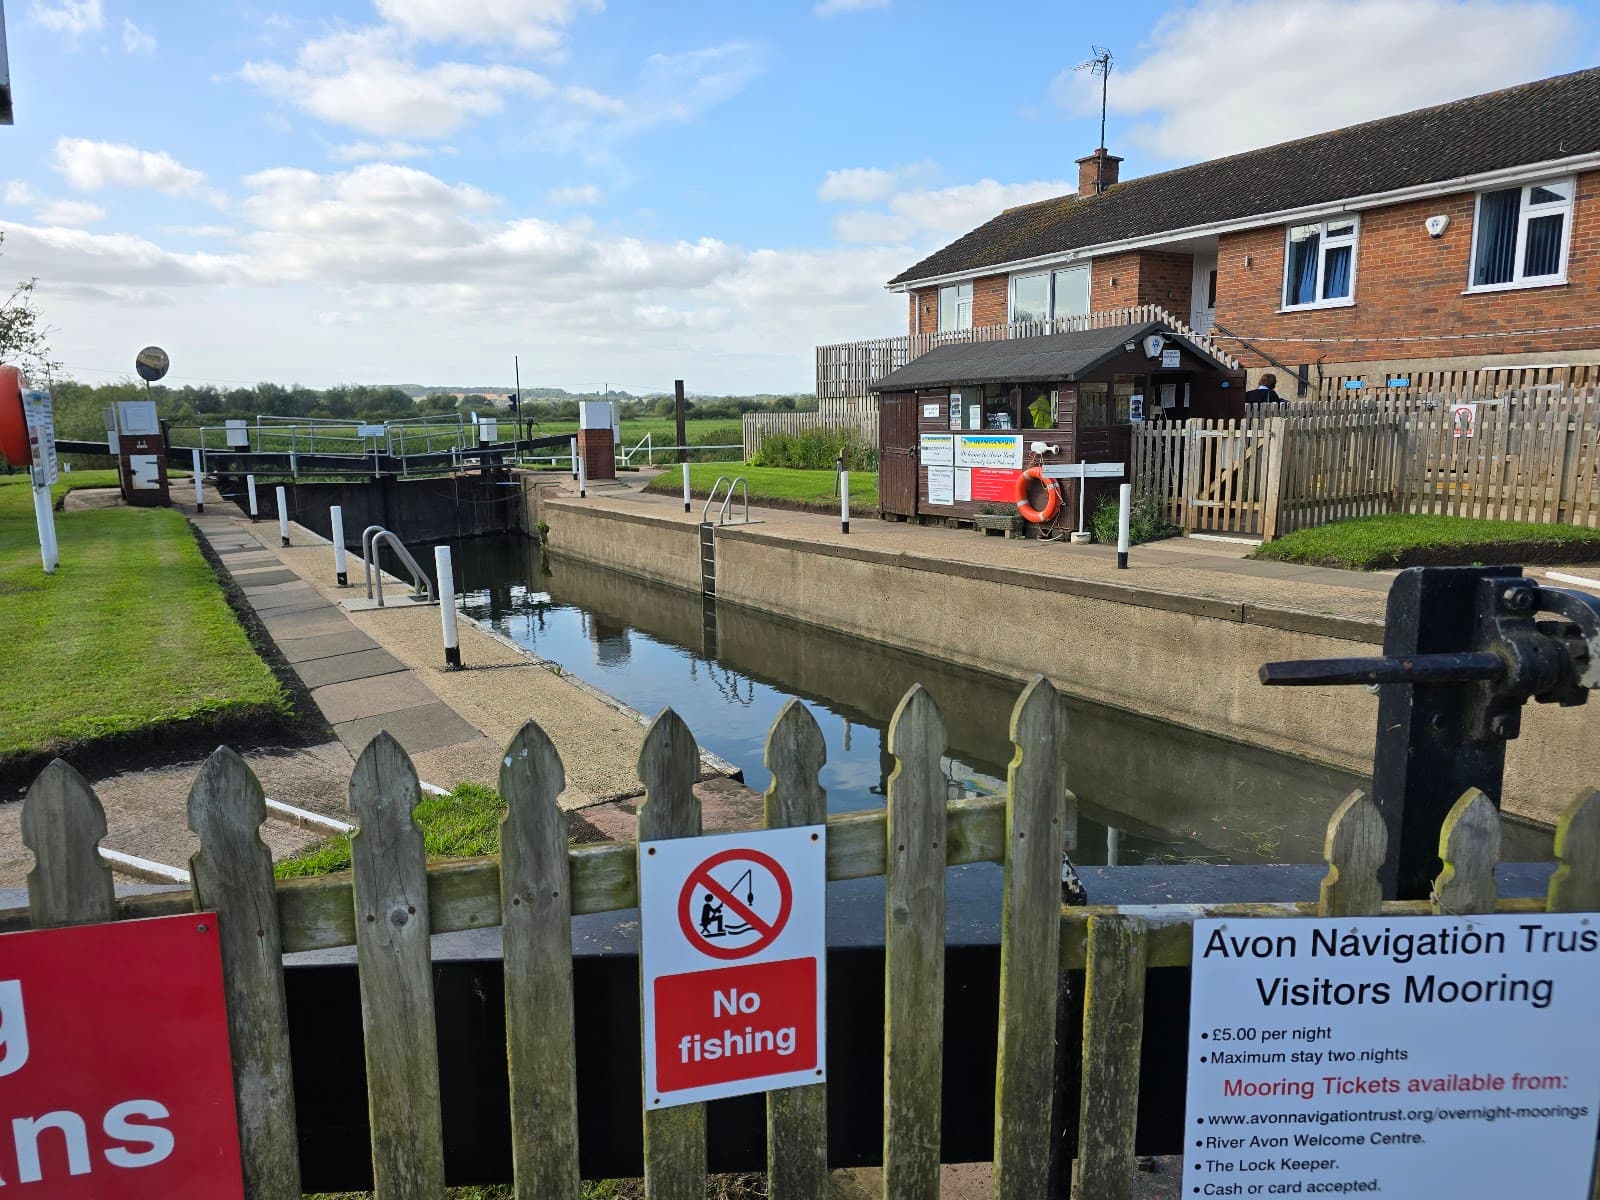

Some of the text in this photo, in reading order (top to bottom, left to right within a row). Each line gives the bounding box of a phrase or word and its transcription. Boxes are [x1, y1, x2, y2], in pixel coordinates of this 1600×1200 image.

[1203, 924, 1599, 963] Avon Navigation Trus
[713, 987, 761, 1018] No
[1256, 973, 1553, 1008] Visitors Mooring
[678, 1026, 796, 1064] fishing
[1212, 1026, 1332, 1043] £5.00 per night
[1211, 1047, 1409, 1066] Maximum stay two nights
[1223, 1072, 1569, 1100] Mooring Tickets available from:
[1208, 1104, 1589, 1126] www.avonnavigationtrust.org/overnight-moorings
[0, 1099, 175, 1187] ns
[1206, 1132, 1426, 1149] River Avon Welcome Centre.
[1206, 1157, 1340, 1173] The Lock Keeper.
[1203, 1178, 1382, 1196] Cash or card accepted.
